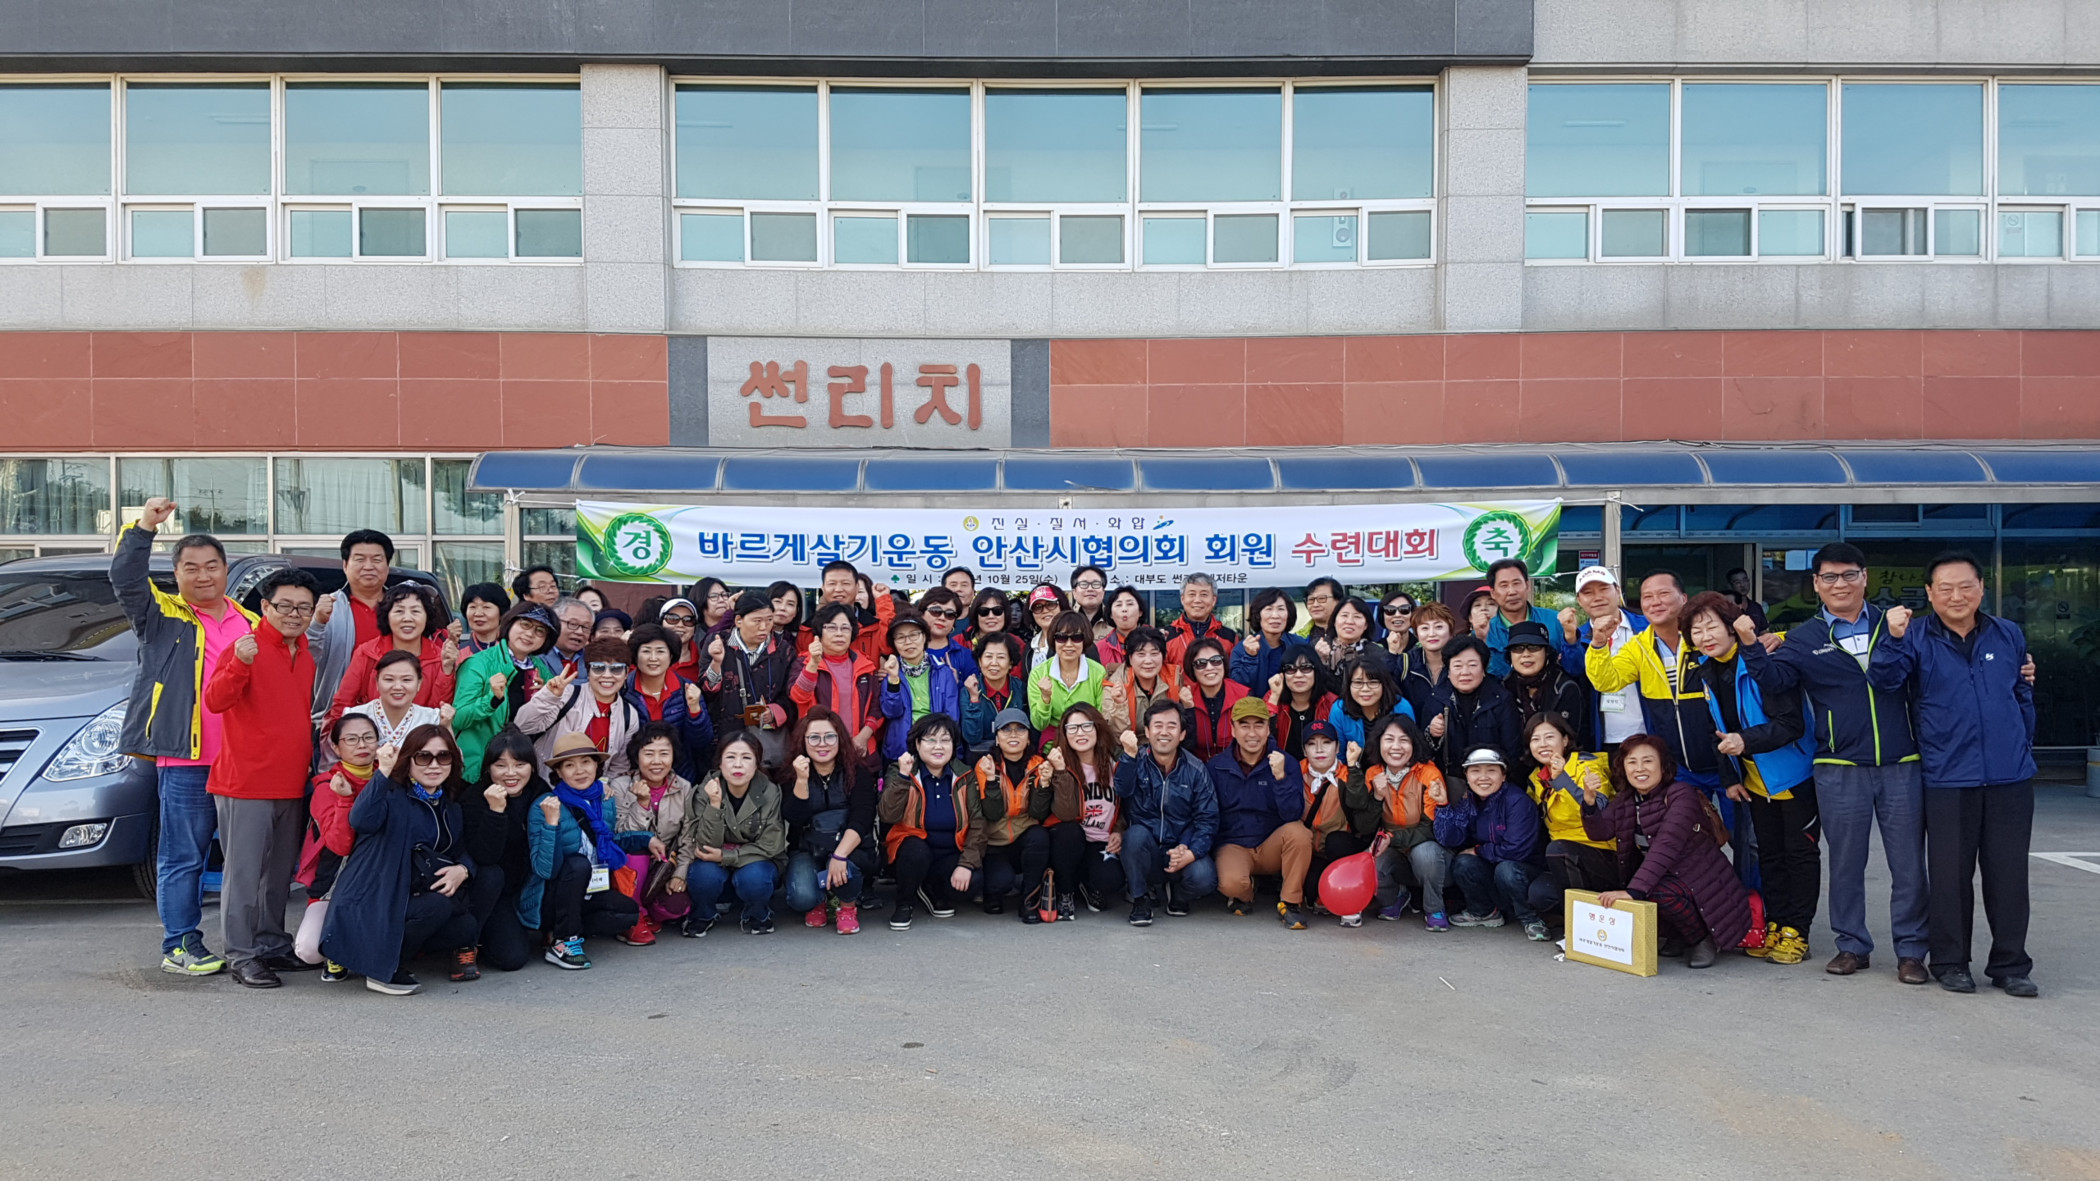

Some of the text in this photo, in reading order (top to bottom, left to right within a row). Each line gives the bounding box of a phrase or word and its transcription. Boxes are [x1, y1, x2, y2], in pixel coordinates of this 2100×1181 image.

[739, 359, 982, 431] 썬리치
[622, 529, 652, 560] 경
[698, 528, 1438, 569] 바르게살기운동 안산시협의회 회원 수련대회
[1480, 527, 1514, 557] 축
[988, 574, 1010, 585] 10월
[1134, 574, 1167, 584] 대부도
[1083, 782, 1117, 806] NDO
